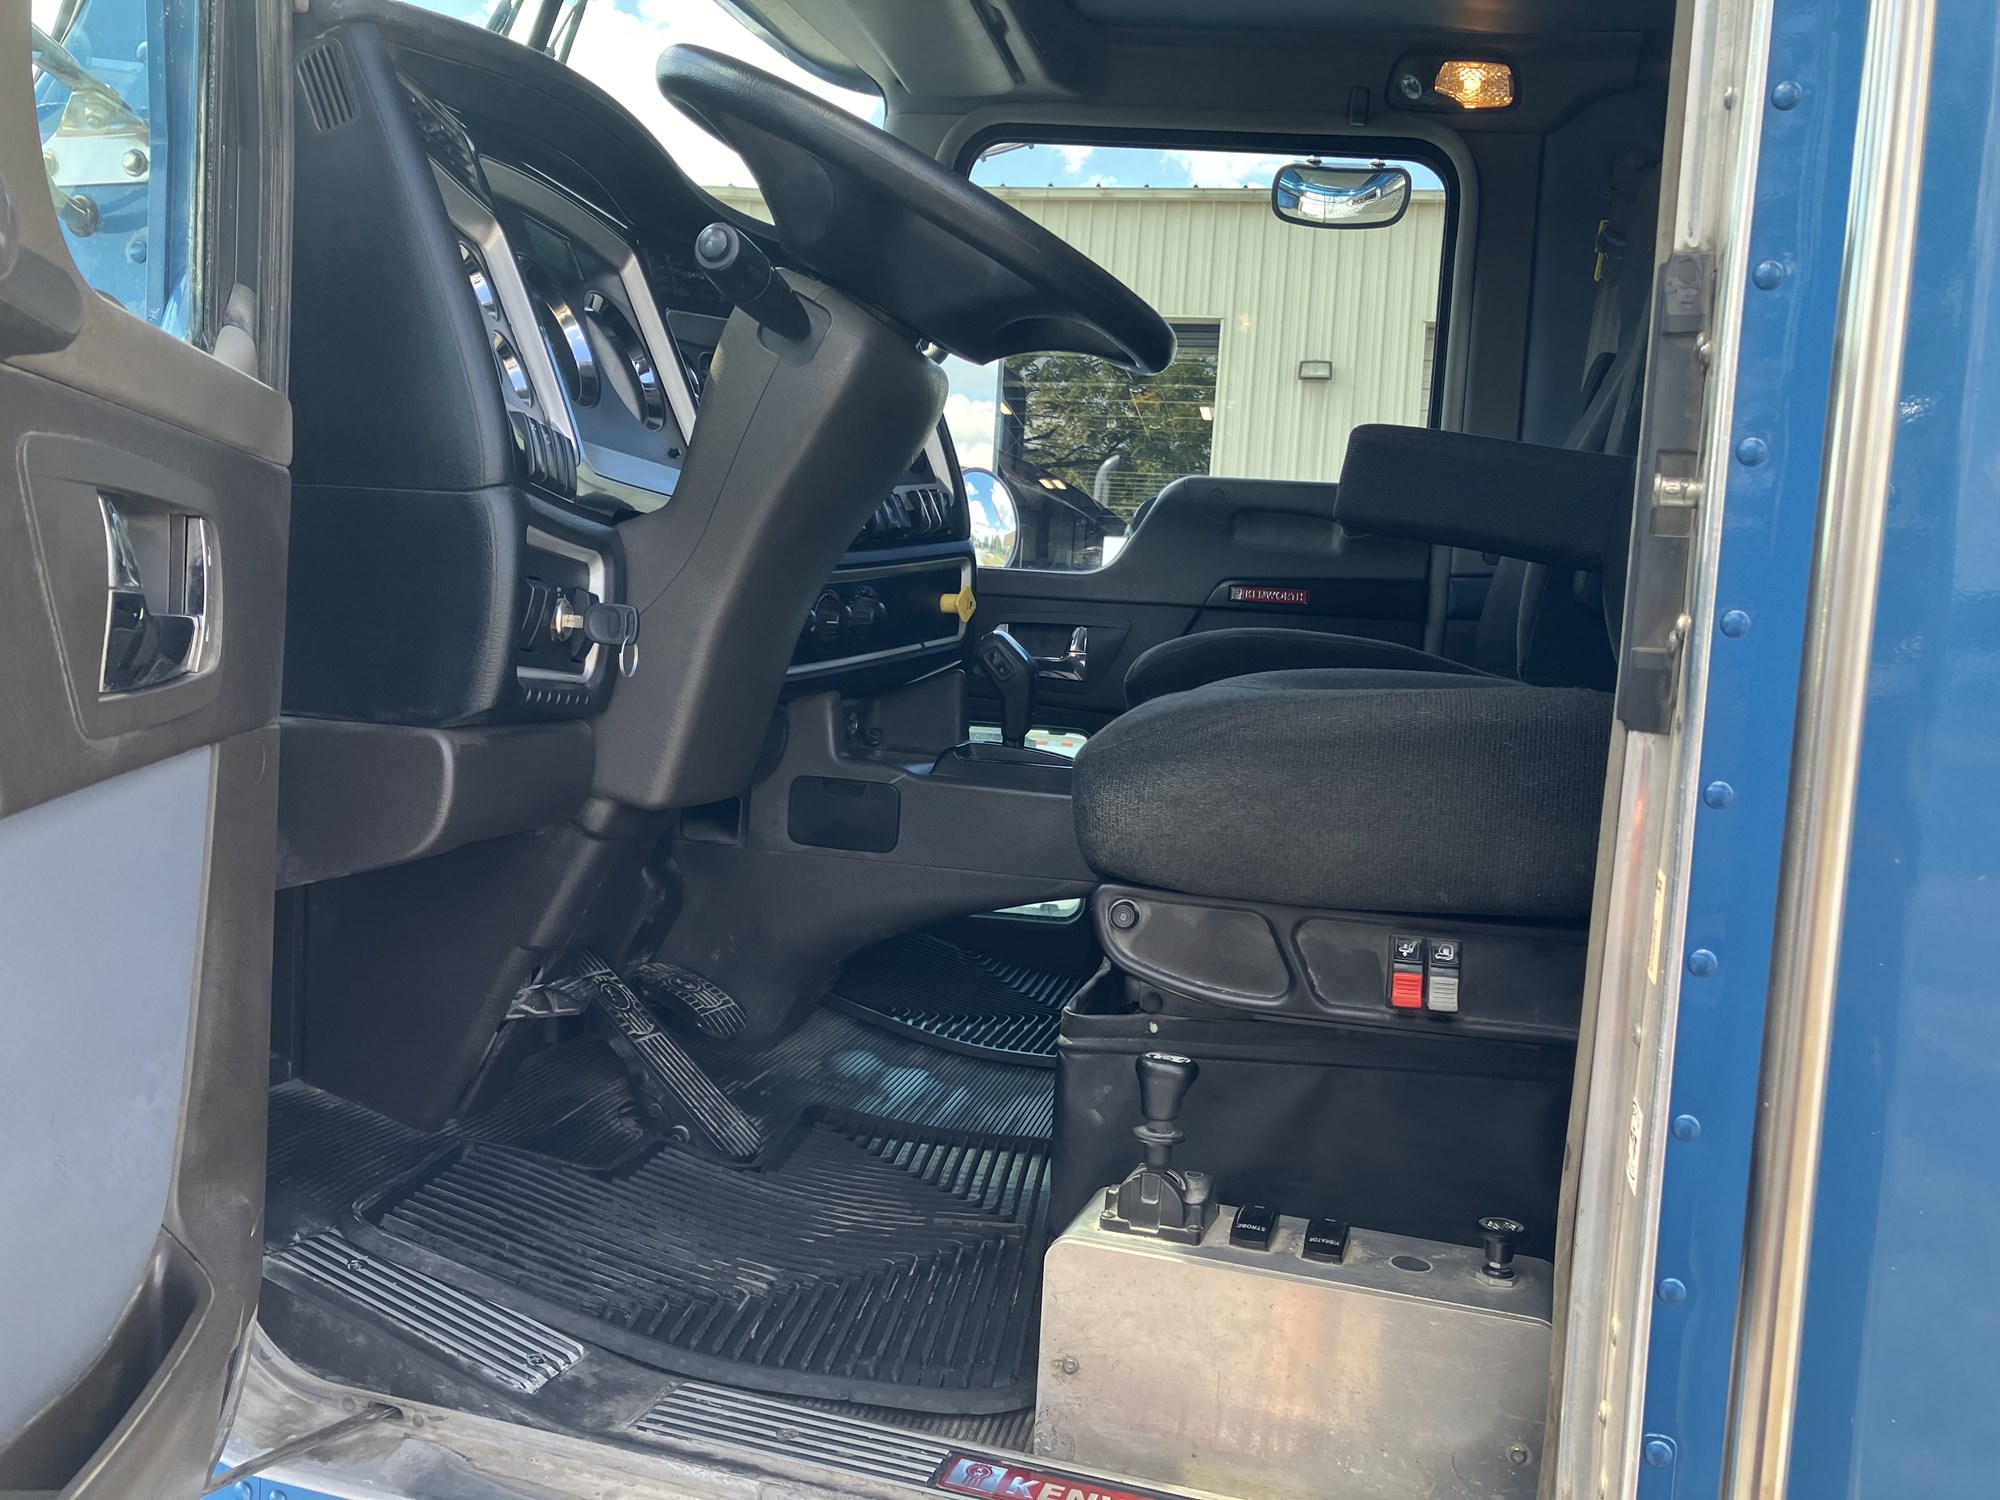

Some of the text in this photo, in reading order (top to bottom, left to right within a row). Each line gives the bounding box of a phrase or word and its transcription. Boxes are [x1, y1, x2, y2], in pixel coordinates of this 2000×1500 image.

[1244, 589, 1304, 602] KENWORTH
[1236, 1222, 1267, 1232] STROBE
[1308, 1236, 1340, 1247] VIBRATOR
[1006, 1476, 1112, 1500] KEN
